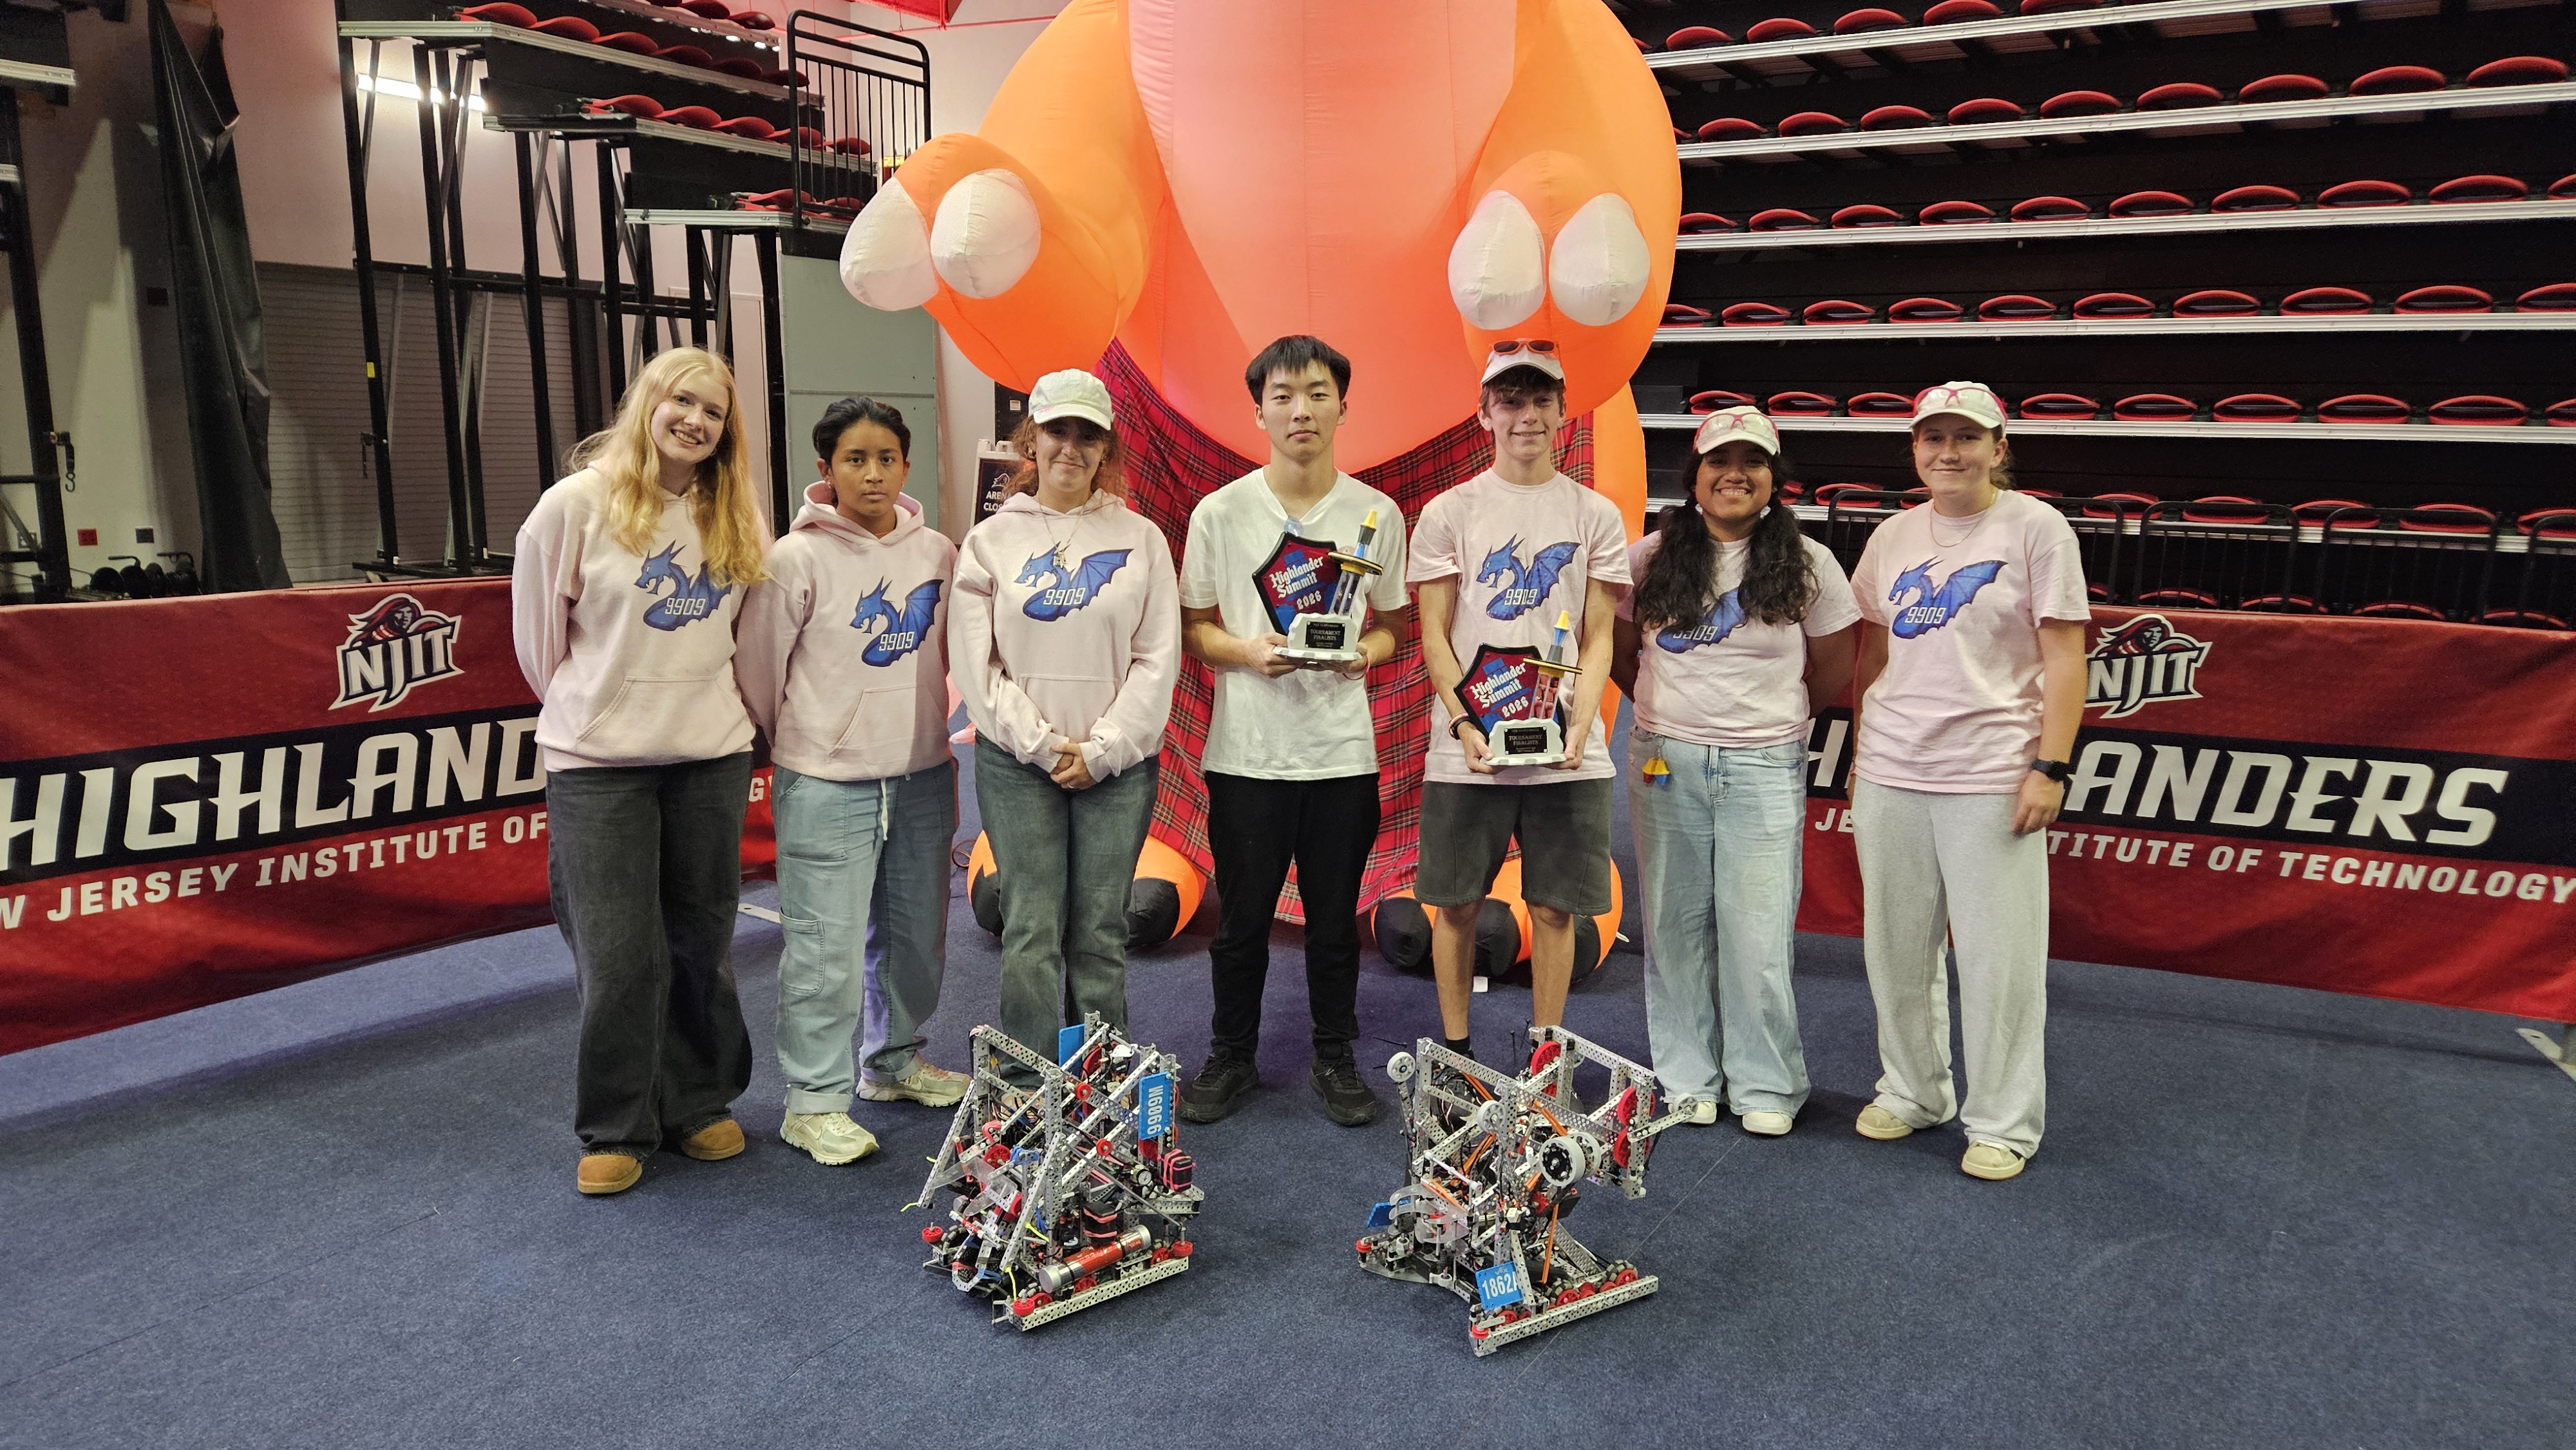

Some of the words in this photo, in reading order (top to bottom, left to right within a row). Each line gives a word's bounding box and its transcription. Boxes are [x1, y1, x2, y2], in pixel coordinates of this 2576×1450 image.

[1269, 556, 1323, 588] Highlander
[1276, 571, 1318, 599] Summit
[665, 598, 706, 616] 9909
[1043, 587, 1086, 605] 9909
[1504, 588, 1538, 605] 9909
[1904, 607, 1947, 624] 9909
[878, 631, 915, 652] 9909
[346, 625, 452, 699] NJIT
[1470, 663, 1526, 700] Highlander
[1479, 678, 1522, 709] Summit
[2087, 650, 2199, 710] NJIT
[1502, 696, 1529, 718] 2026
[0, 717, 548, 871] HIGHLAND
[47, 862, 238, 922] JERSEY
[255, 821, 488, 887] INSTITUTE
[502, 811, 547, 843] OF
[2047, 830, 2195, 867] TITUTE
[2208, 844, 2264, 873] OF
[2278, 851, 2576, 903] TECHNOLOGY
[1147, 1085, 1164, 1135] 9909M
